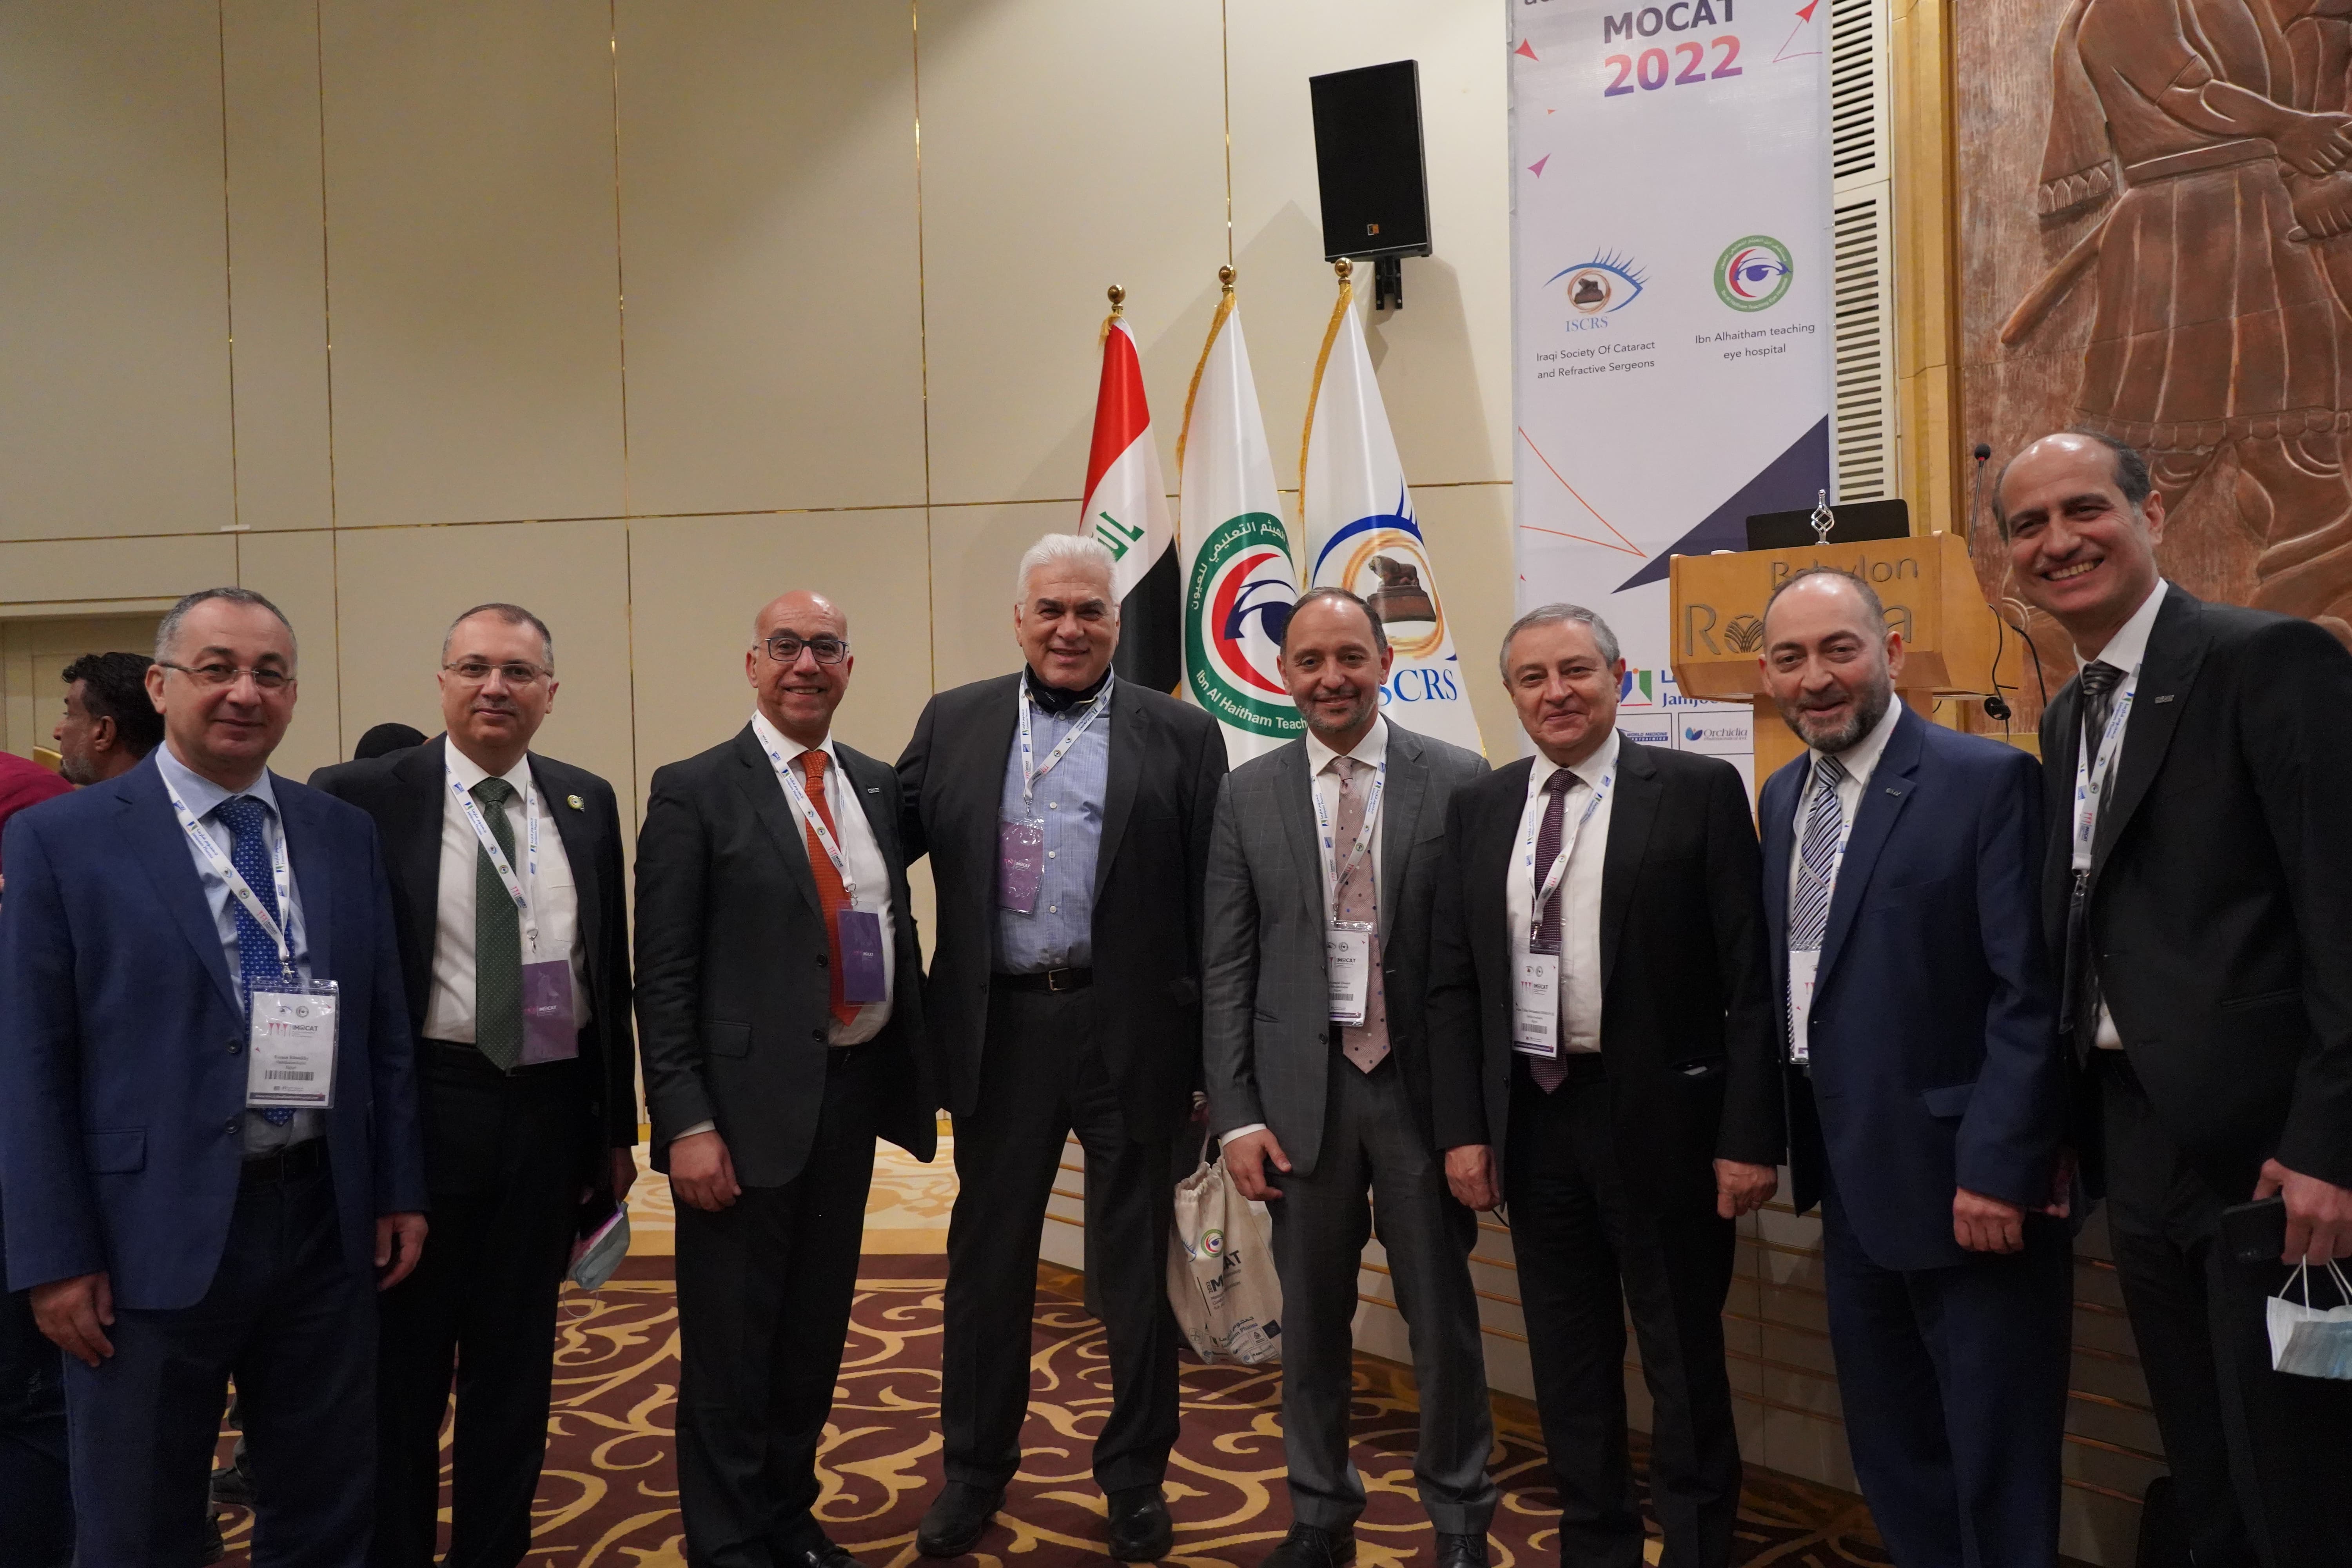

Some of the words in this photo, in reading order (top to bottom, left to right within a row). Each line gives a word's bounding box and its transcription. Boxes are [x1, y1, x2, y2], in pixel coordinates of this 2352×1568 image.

[1604, 0, 1734, 44] MOCAT
[1604, 35, 1742, 97] 2022
[1566, 316, 1608, 332] ISCRS
[1696, 335, 1711, 343] Ibn
[1715, 329, 1766, 341] Alhaitham
[1770, 324, 1815, 336] teaching
[1537, 352, 1557, 362] Iraqi
[1561, 349, 1595, 358] Society
[1599, 345, 1611, 354] Of
[1614, 341, 1655, 352] Cataract
[1724, 351, 1741, 361] eye
[1746, 343, 1786, 357] hospital
[1538, 369, 1555, 379] and
[1559, 365, 1606, 377] Refractive
[1609, 360, 1655, 372] Sergeons
[1209, 521, 1256, 562] التعليمي
[1192, 563, 1208, 610] للعيون
[1771, 555, 1918, 590] Blon
[1196, 670, 1209, 691] Ibn
[1207, 688, 1222, 702] Al
[1219, 697, 1272, 727] Haitham
[1276, 717, 1307, 729] Teach
[1379, 669, 1457, 706] SCRS
[1704, 728, 1747, 737] Orchidia
